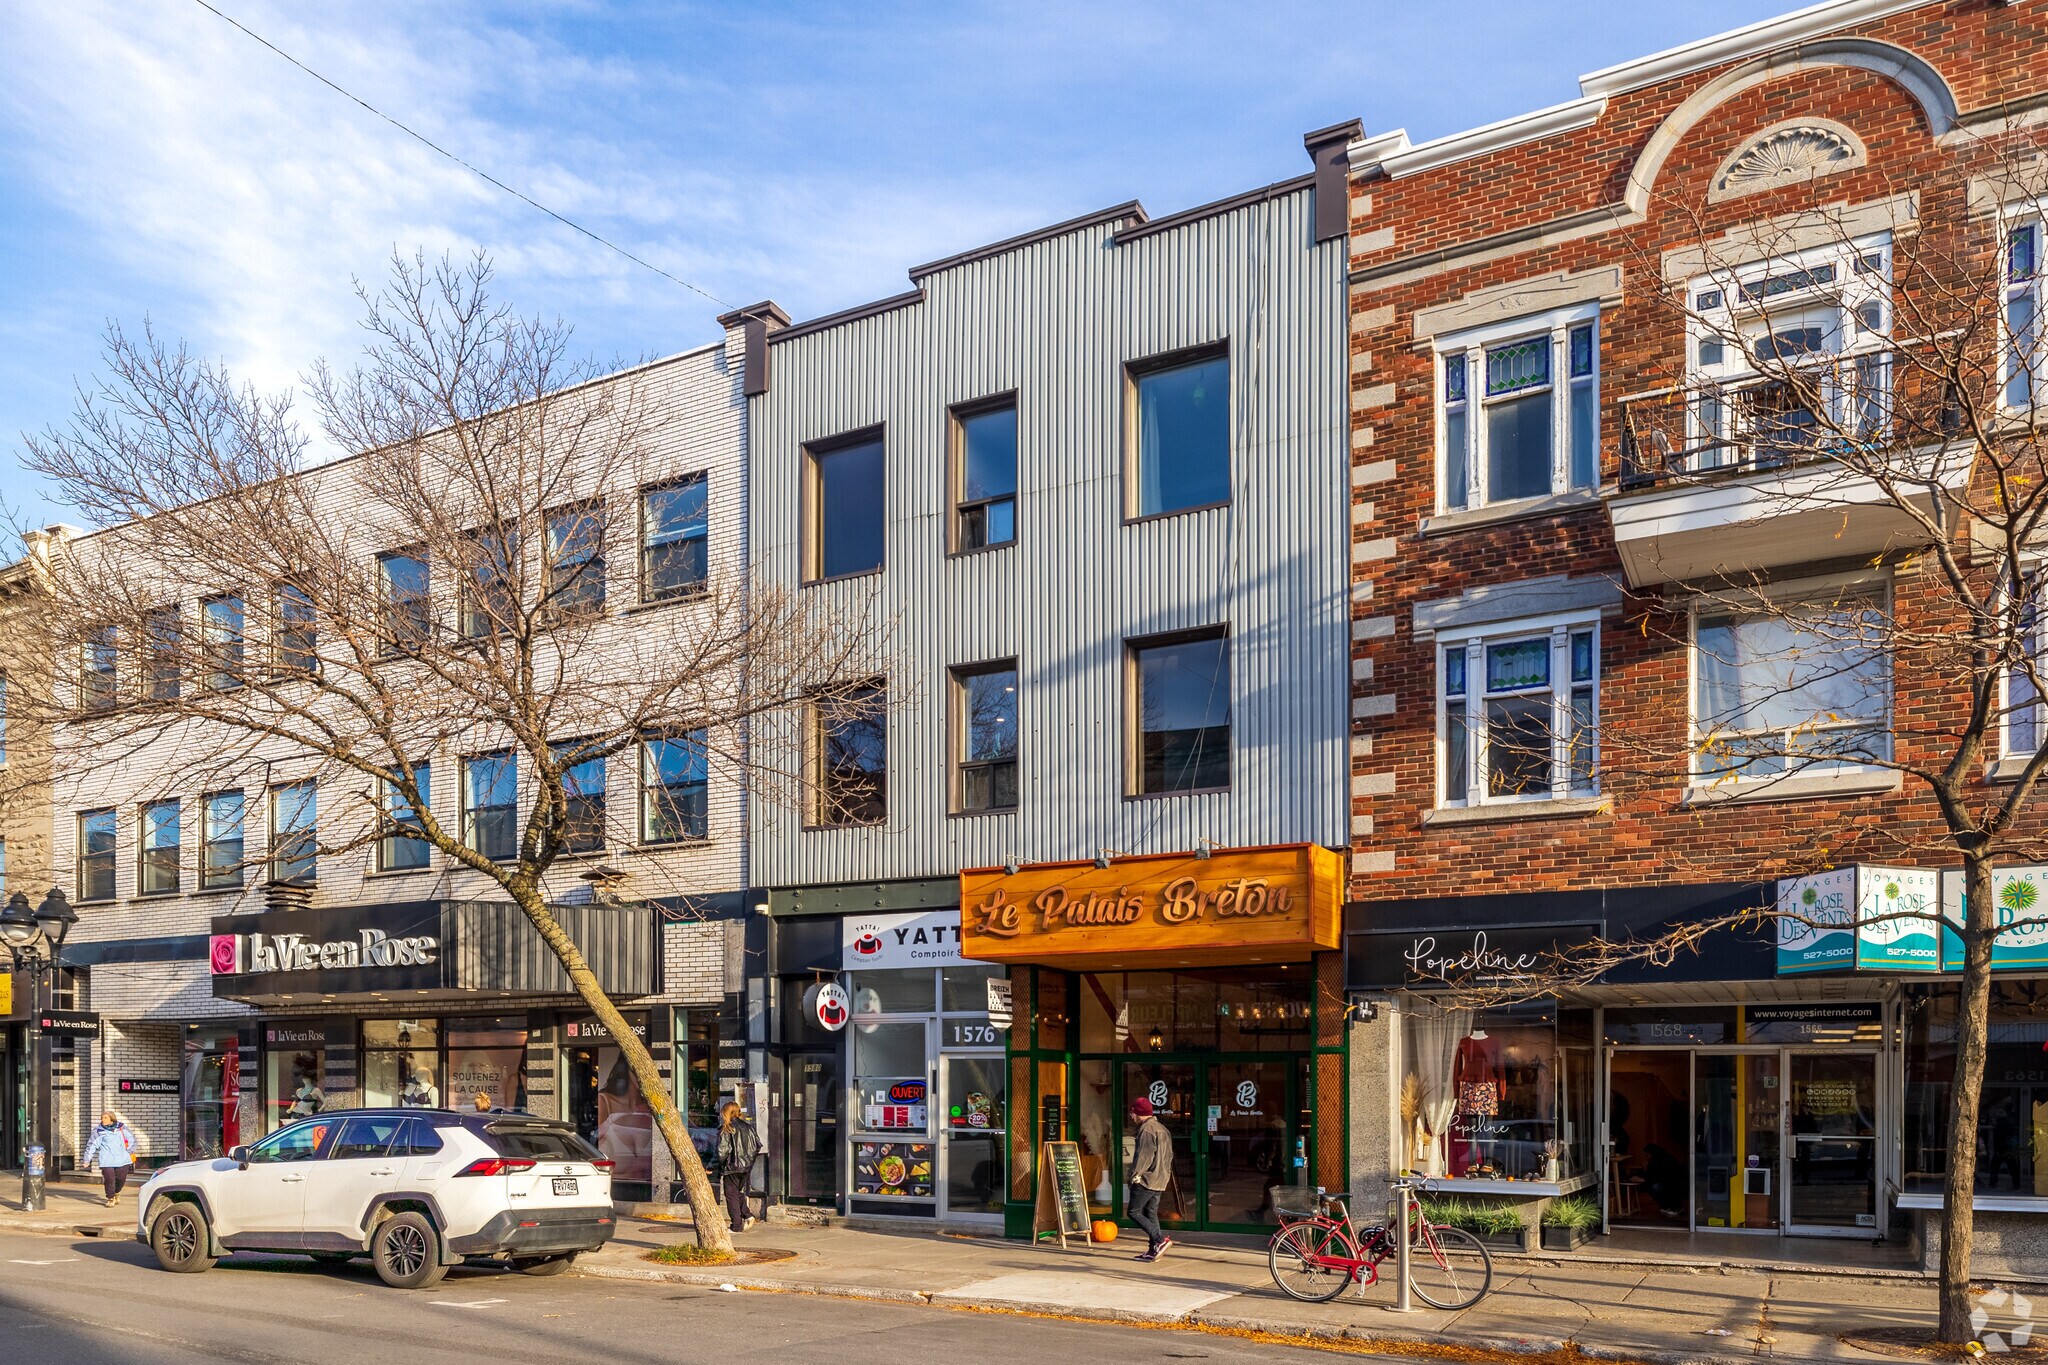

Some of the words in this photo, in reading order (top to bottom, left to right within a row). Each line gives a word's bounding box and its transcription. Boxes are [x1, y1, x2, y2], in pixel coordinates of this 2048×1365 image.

[1781, 873, 1852, 892] VOYAGES
[1864, 873, 1934, 885] VOYAGES
[975, 887, 1021, 937] Le
[1035, 884, 1145, 930] Palais
[1161, 876, 1295, 924] Breton
[1792, 903, 1810, 924] LA
[1814, 892, 1843, 915] ROSE
[1874, 894, 1891, 915] LA
[1897, 893, 1925, 912] ROSE
[855, 924, 881, 932] YATTA!
[1781, 918, 1806, 940] DES
[1811, 909, 1854, 939] VENTS
[249, 933, 273, 972] la
[271, 933, 321, 971] Vie
[320, 940, 358, 969] en
[359, 928, 437, 967] Rose
[911, 949, 955, 959] Comptoir
[1404, 931, 1537, 981] Popeline
[1803, 948, 1853, 959] 527-5000
[1886, 947, 1936, 958] 527-5000
[822, 989, 845, 1000] YATTA!
[989, 984, 1010, 993] BREIZH
[1754, 1008, 1872, 1020] www.voyagesinternet.com
[60, 1020, 71, 1028] Vie
[81, 1021, 97, 1029] Rose
[582, 1023, 590, 1036] la
[590, 1023, 607, 1036] Vie
[1651, 1023, 1682, 1037] 1568
[1800, 1024, 1822, 1034] 1566
[278, 1030, 285, 1041] la
[285, 1030, 297, 1041] Vie
[298, 1033, 307, 1041] en
[954, 1026, 995, 1043] 1576
[453, 1072, 500, 1081] SOUTENEZ
[133, 1082, 140, 1090] la
[140, 1082, 151, 1090] Vie
[161, 1083, 178, 1091] Rose
[455, 1085, 467, 1094] LA
[470, 1085, 498, 1094] CAUSE
[891, 1086, 925, 1099] OUVERT
[1448, 1112, 1510, 1137] Popeline
